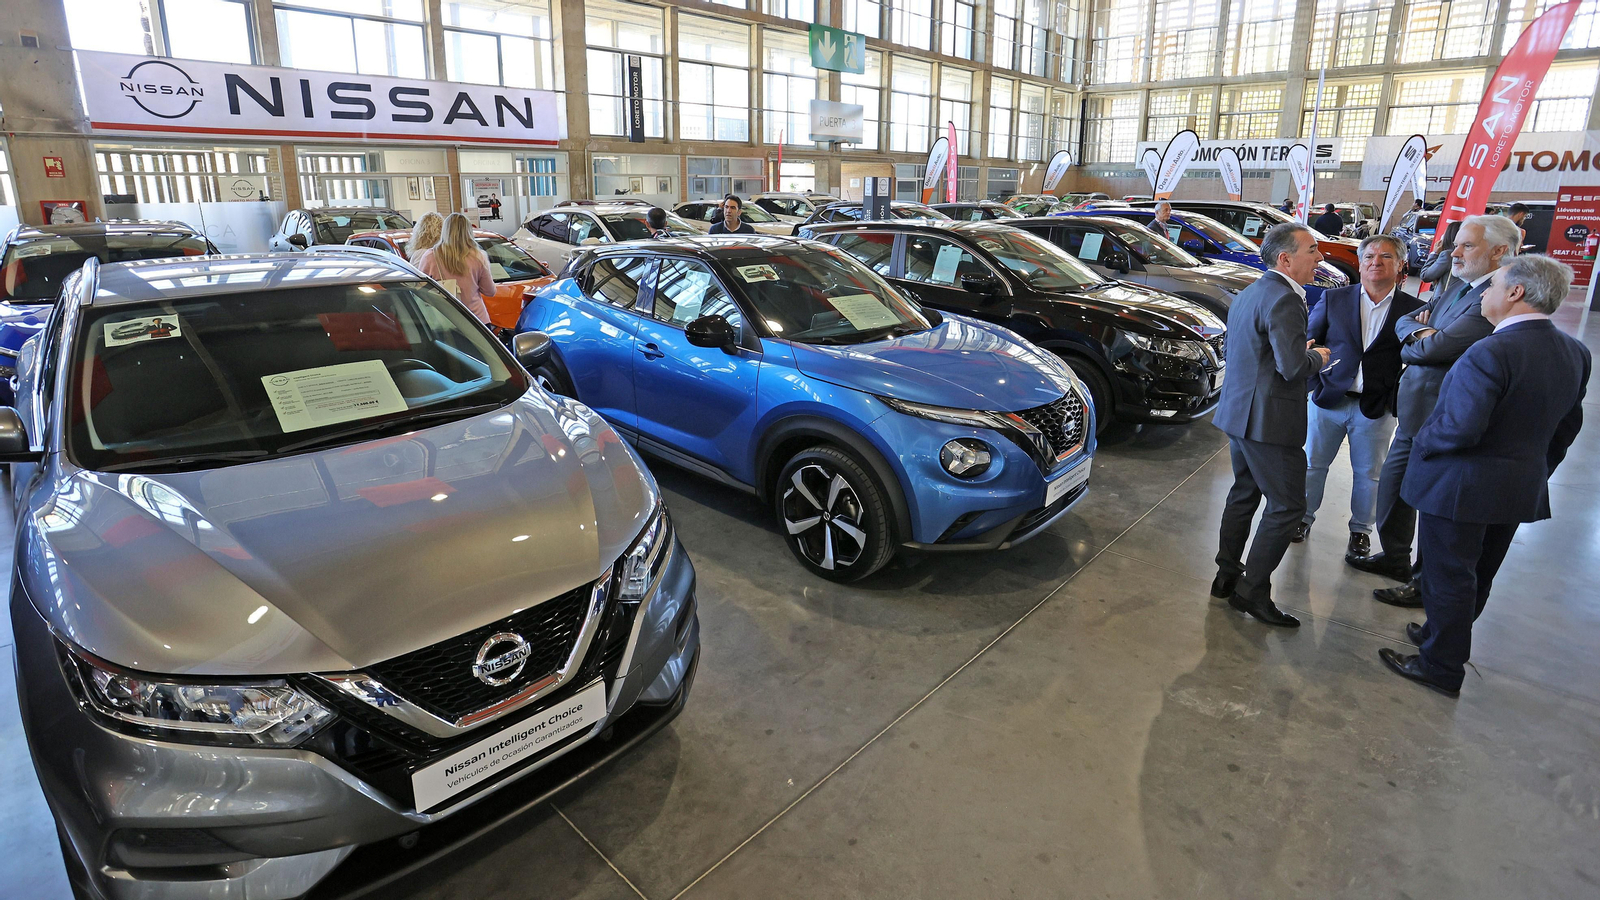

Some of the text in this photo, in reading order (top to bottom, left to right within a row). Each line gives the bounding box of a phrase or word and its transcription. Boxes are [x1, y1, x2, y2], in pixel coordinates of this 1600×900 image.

[120, 82, 204, 96] NISSAN
[225, 73, 534, 129] NISSAN
[820, 116, 847, 128] PUERTA
[1490, 80, 1534, 168] LORETO MOTOR
[1158, 178, 1168, 190] Das
[480, 650, 527, 674] NISSAN
[444, 703, 583, 776] Nissan Intelligent Choice
[447, 716, 583, 789] Vehículos de Ocasión Garantizados
